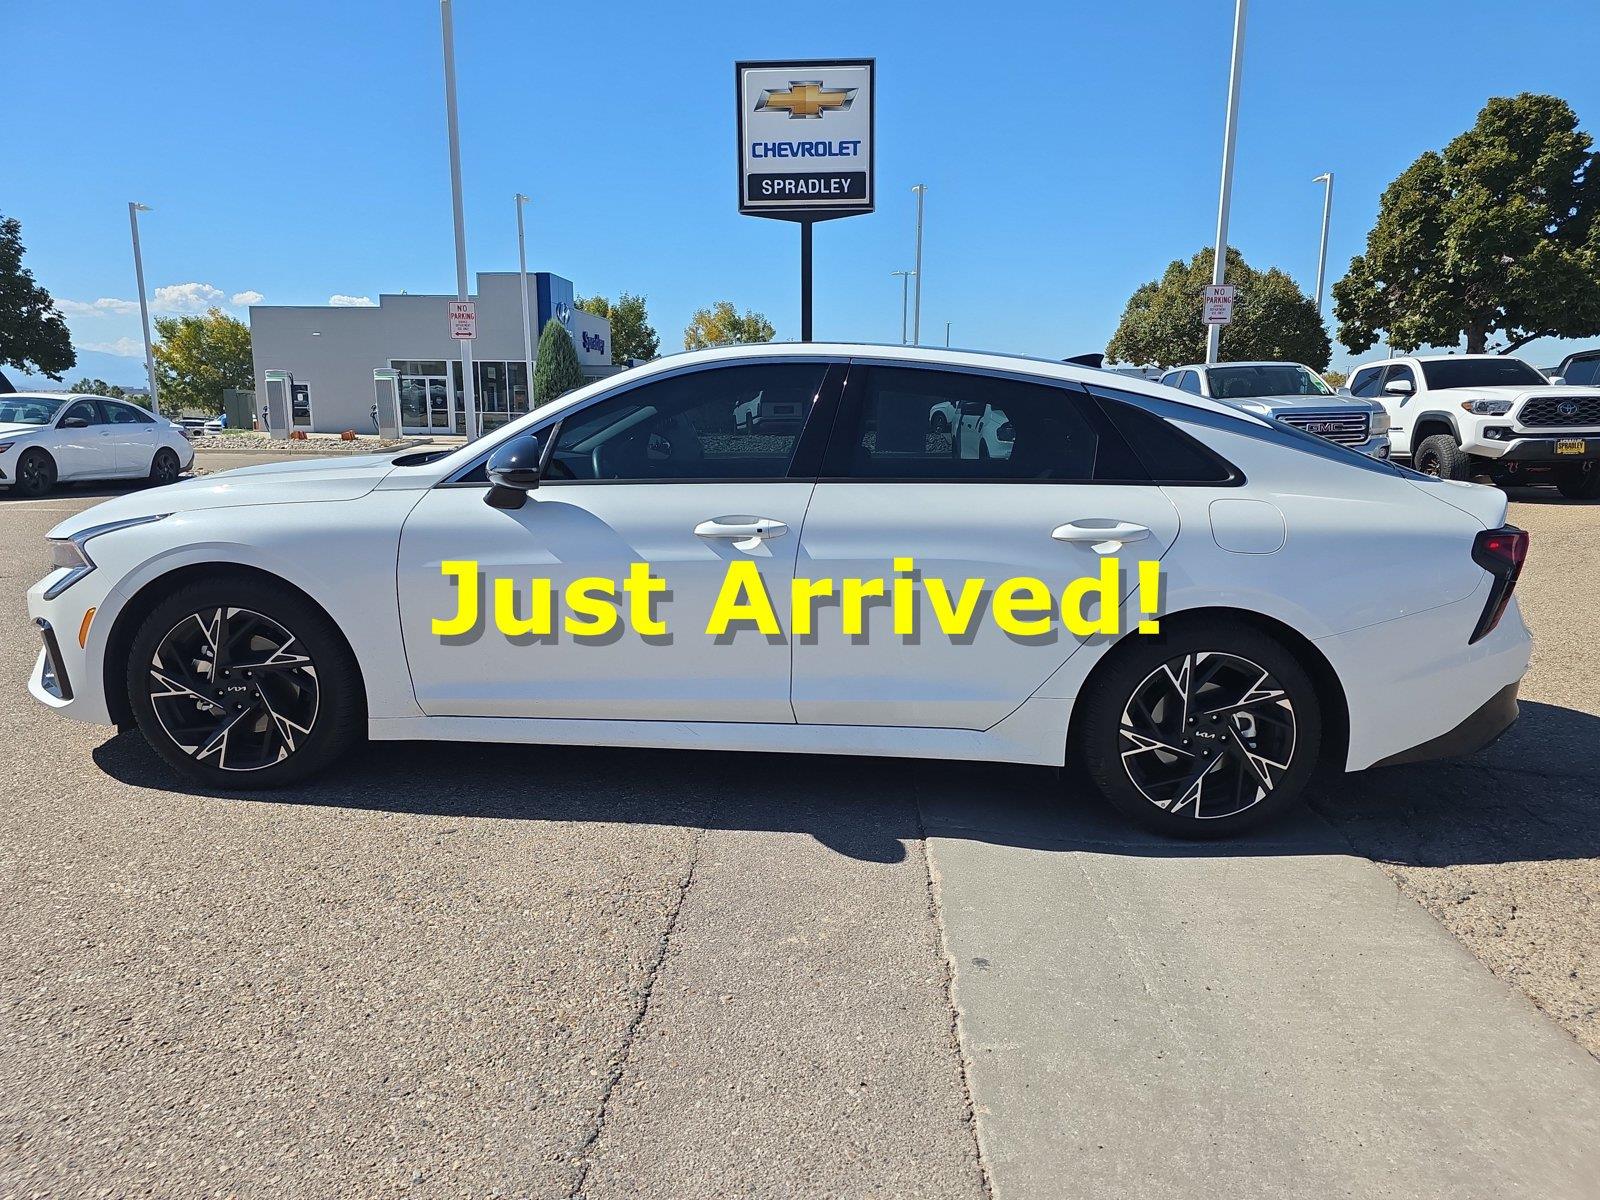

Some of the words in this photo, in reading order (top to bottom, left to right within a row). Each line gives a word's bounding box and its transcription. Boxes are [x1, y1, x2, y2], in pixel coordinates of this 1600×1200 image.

[752, 140, 861, 158] CHEVROLET
[762, 178, 851, 194] SPRADLEY
[1214, 288, 1225, 296] NO
[1206, 296, 1231, 304] PARKING
[457, 304, 468, 312] NO
[450, 312, 475, 320] PARKING
[1306, 423, 1344, 432] GMC
